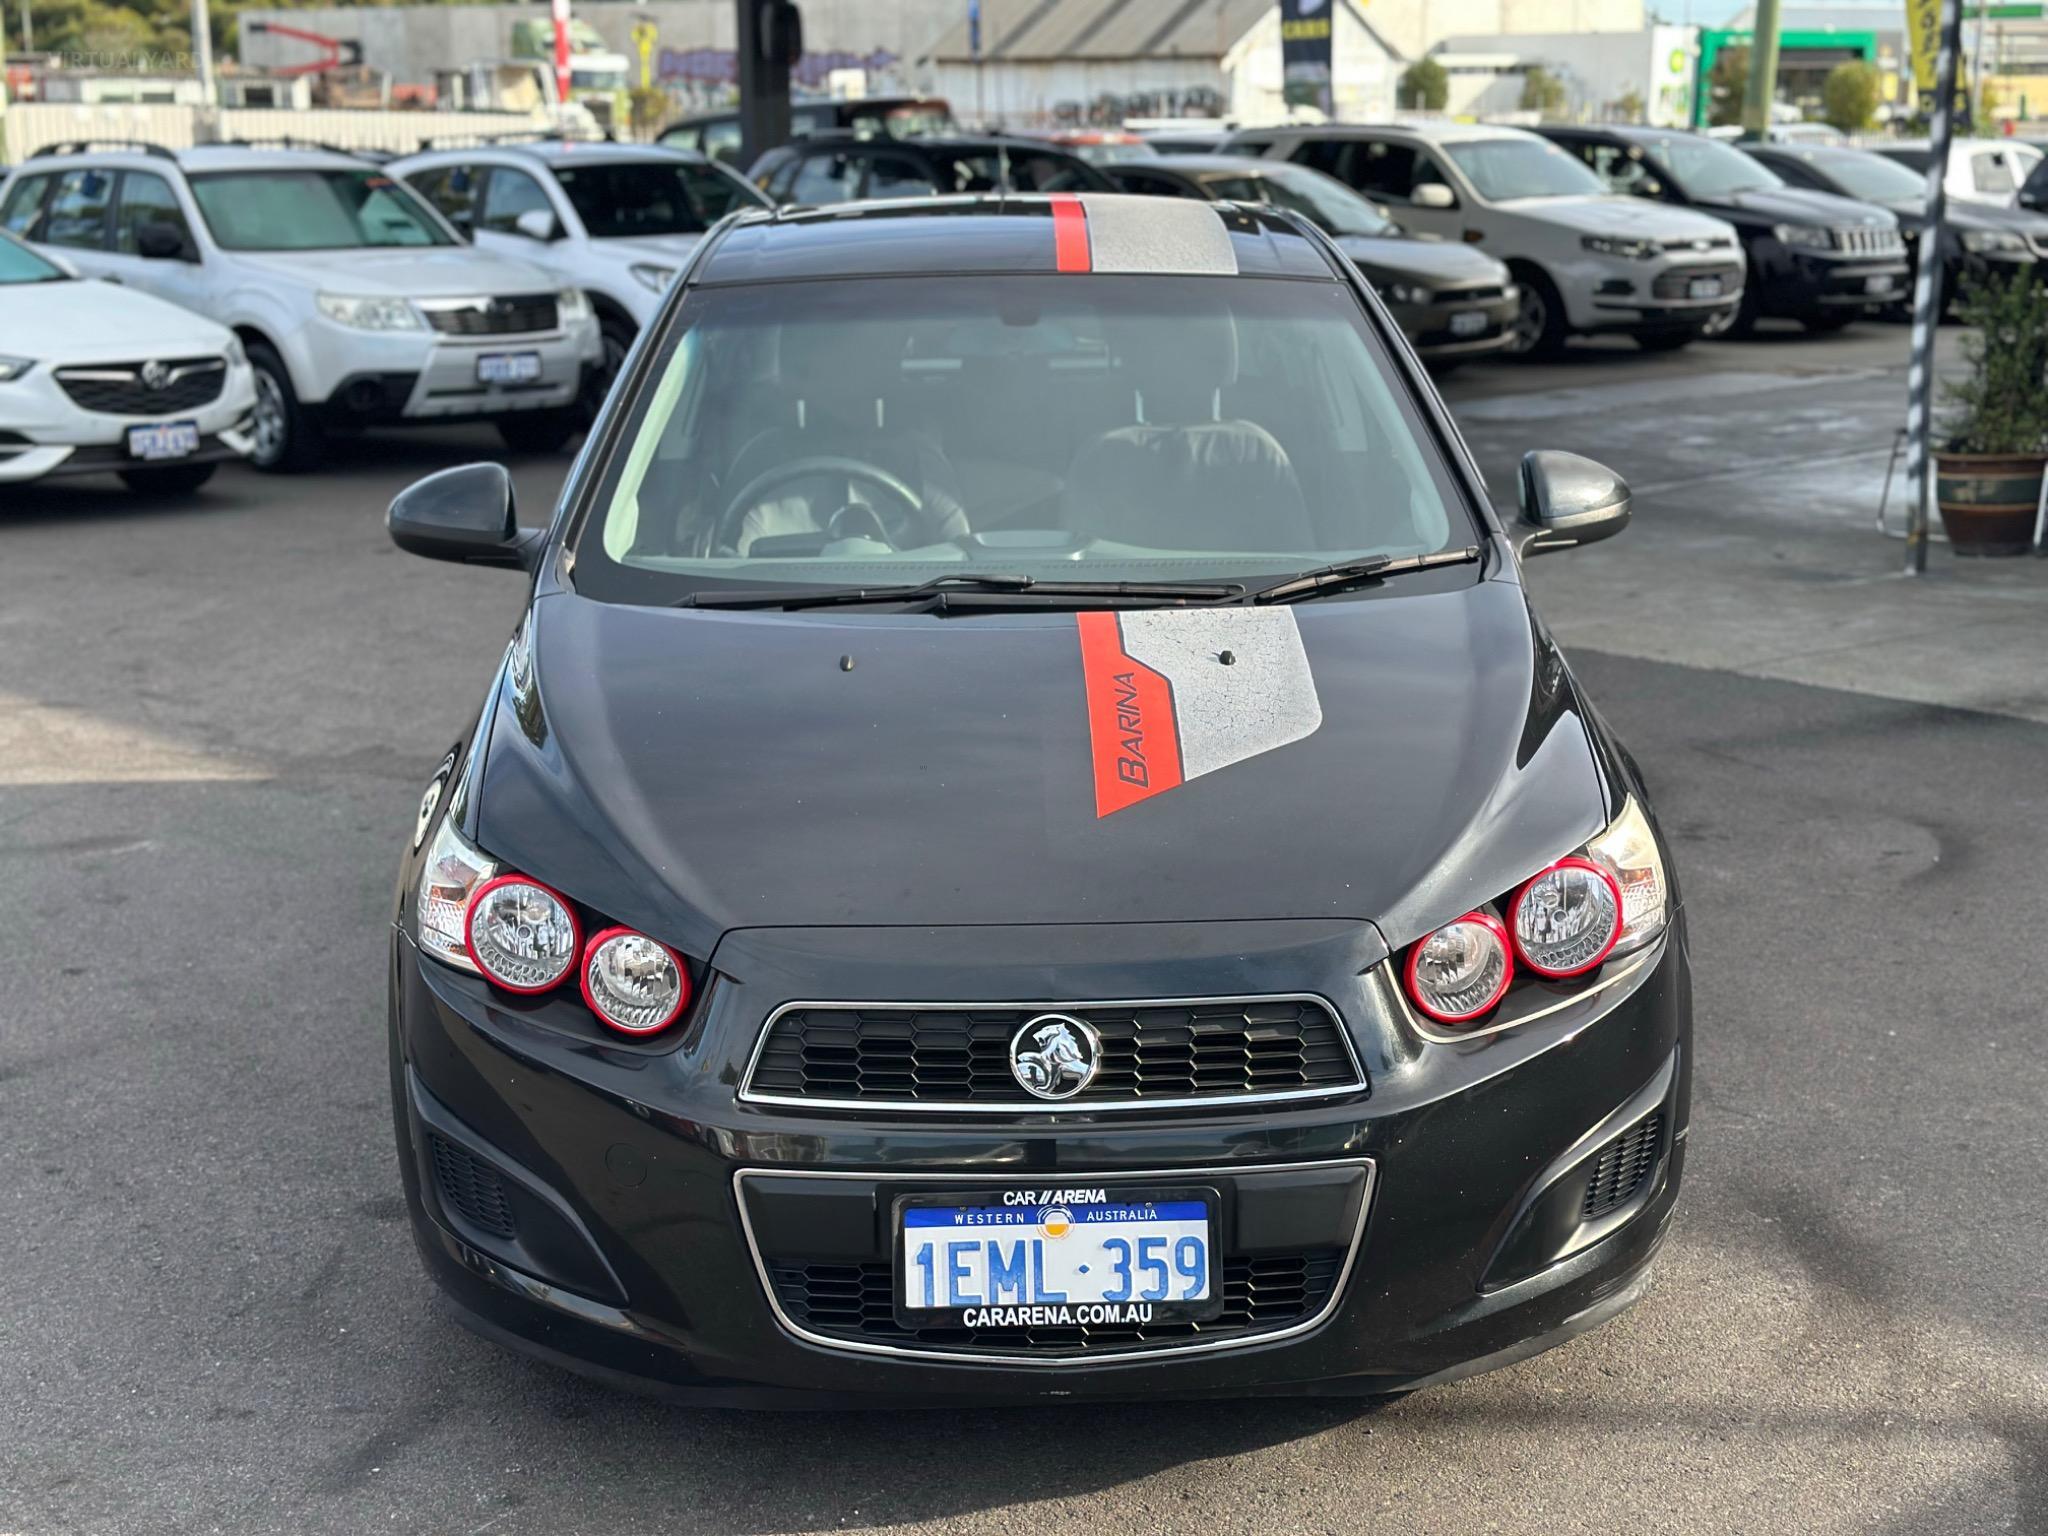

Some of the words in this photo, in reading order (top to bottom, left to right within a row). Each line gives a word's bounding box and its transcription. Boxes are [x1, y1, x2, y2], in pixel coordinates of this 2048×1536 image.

[1114, 672, 1149, 788] BARINA
[1003, 1191, 1036, 1205] CAR
[955, 1213, 1024, 1224] WESTERN
[1087, 1209, 1158, 1222] AUSTRALIA
[963, 1303, 1153, 1327] CARARENA.COM.AU
